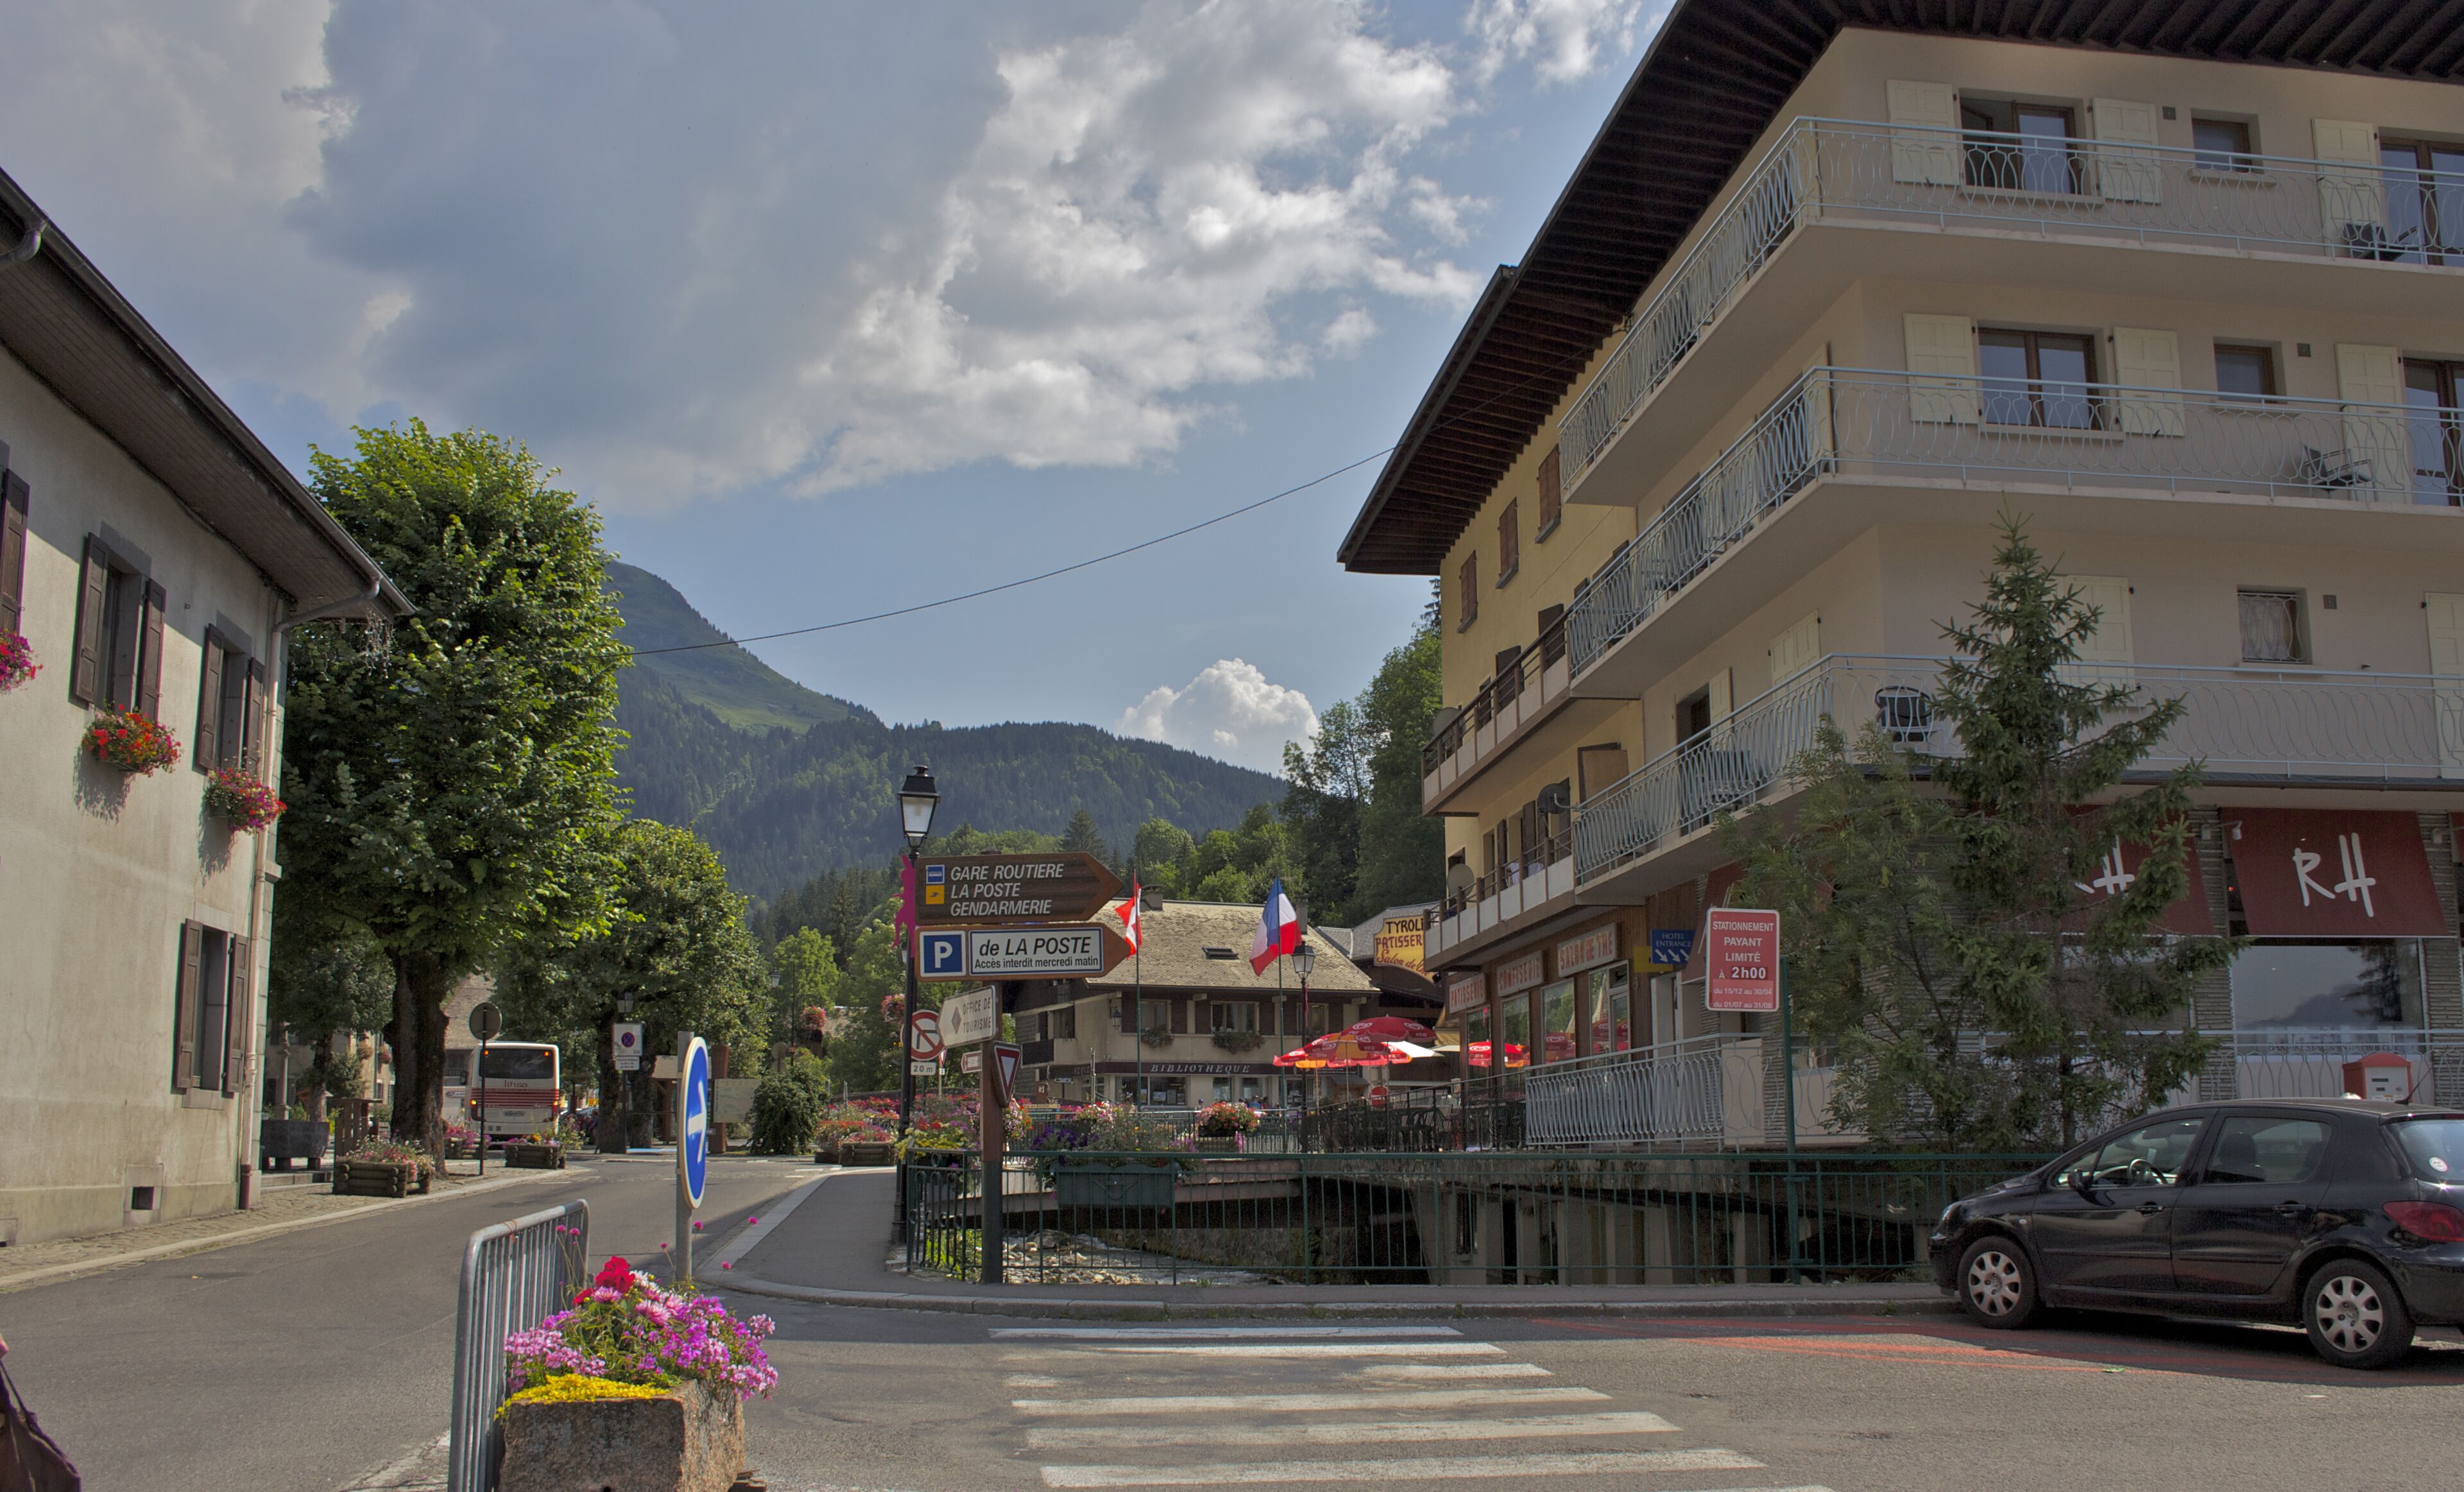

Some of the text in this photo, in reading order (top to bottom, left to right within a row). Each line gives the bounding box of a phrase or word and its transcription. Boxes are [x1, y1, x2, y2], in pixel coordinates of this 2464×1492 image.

[950, 864, 1065, 881] GARE ROUTIERE
[2293, 832, 2375, 917] RH
[950, 882, 1021, 898] LA POSTE
[950, 899, 1052, 916] GENDARMERIE
[1713, 921, 1774, 932] STATIONNEMENT
[979, 936, 1091, 956] de LA POSTE
[1724, 937, 1763, 947] PAYANT
[934, 941, 953, 969] P
[975, 956, 1099, 969] Accès interdit mercredi matin
[1376, 948, 1404, 966] Salon
[1405, 959, 1416, 970] de
[1725, 952, 1761, 962] LIMITÉ
[1718, 966, 1766, 979] À 2h00
[1451, 979, 1483, 1007] PATISSERIE
[963, 997, 991, 1015] OFFICE DE
[963, 1016, 991, 1034] TOURISME
[1151, 1064, 1251, 1074] BIBLIOTHEQUE
